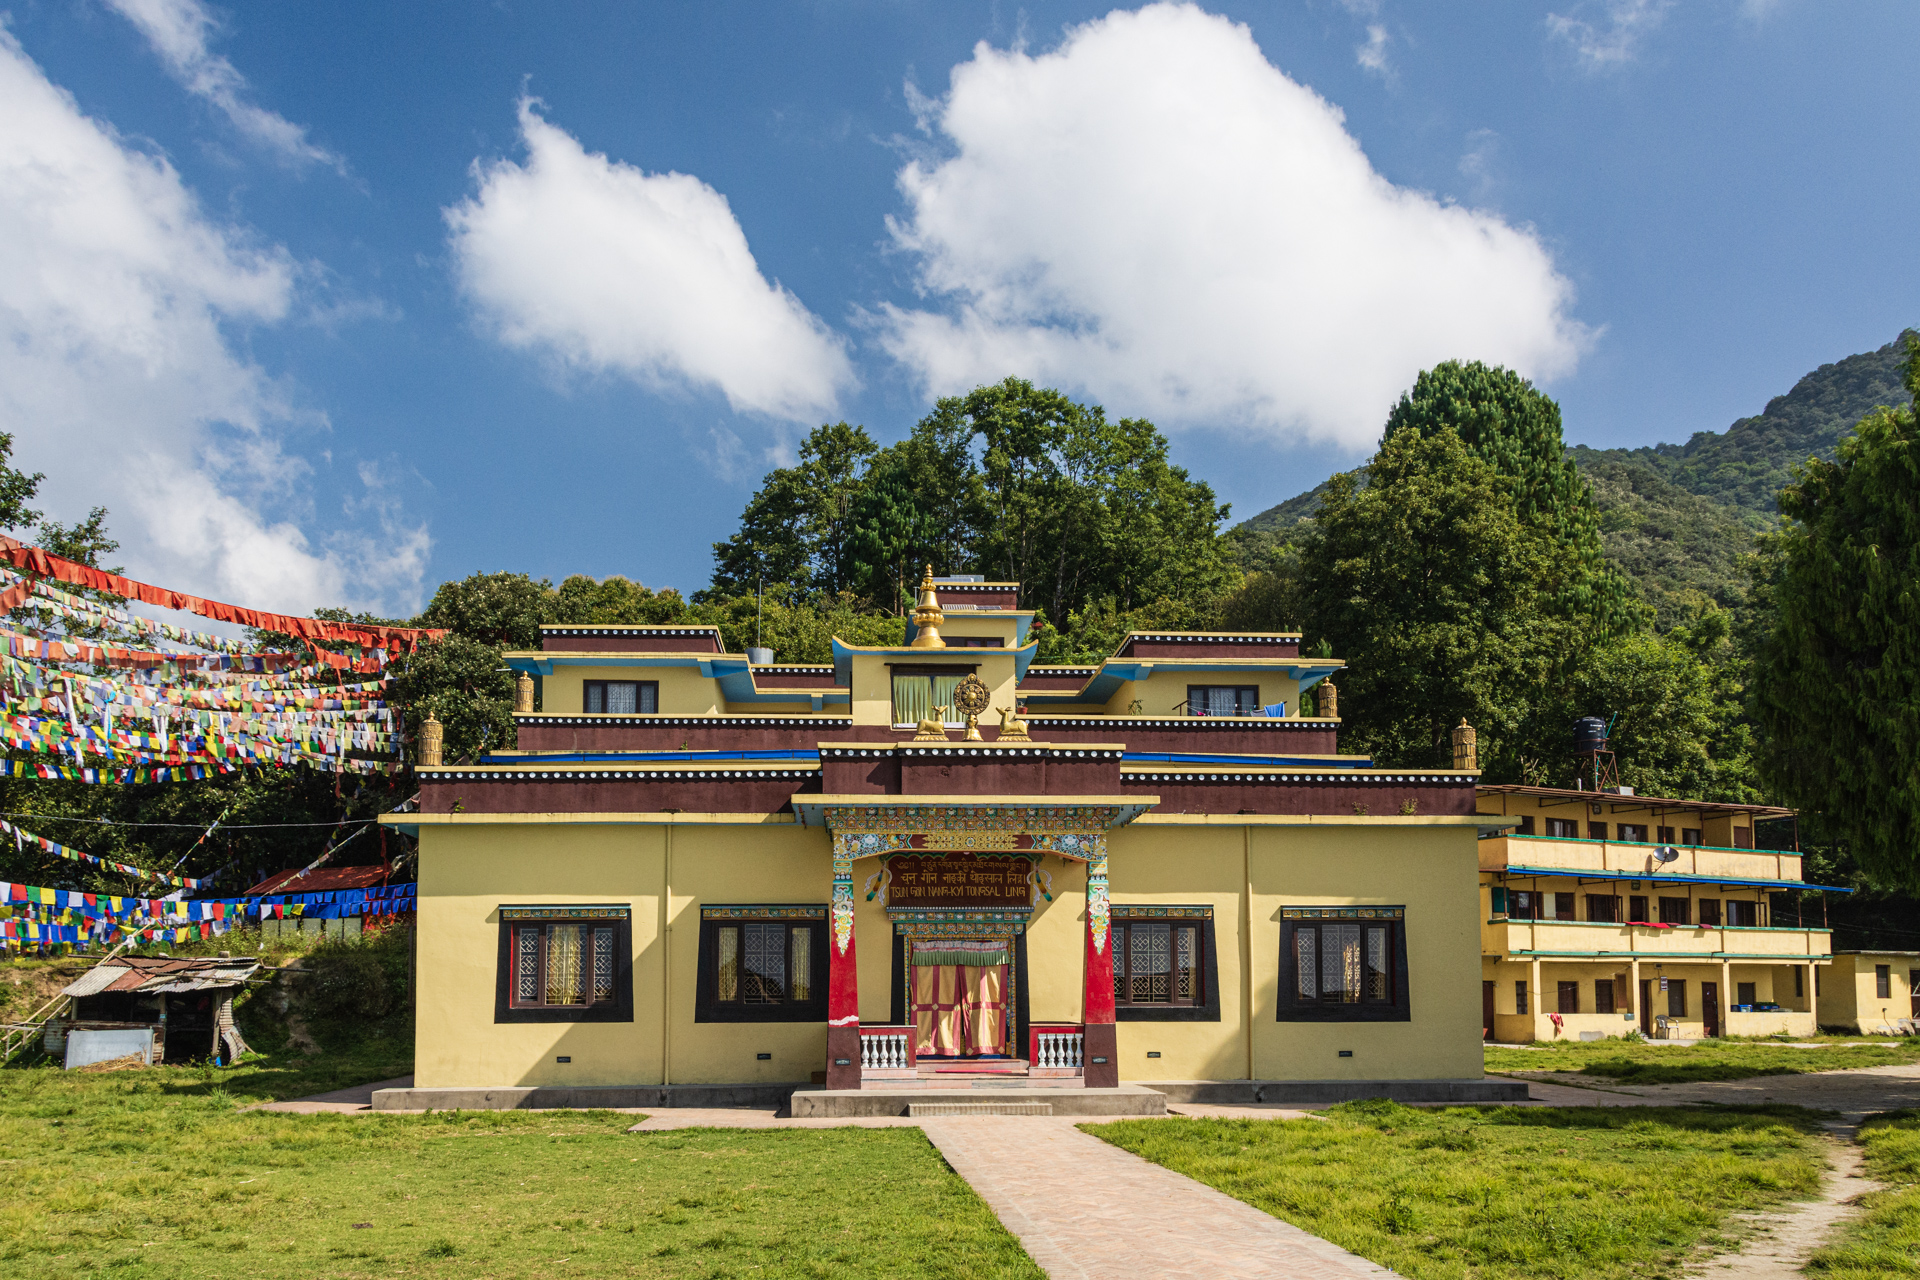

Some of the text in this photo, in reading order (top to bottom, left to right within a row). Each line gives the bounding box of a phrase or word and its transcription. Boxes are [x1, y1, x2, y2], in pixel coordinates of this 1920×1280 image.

[920, 870, 938, 884] गोन
[890, 886, 909, 898] TSUN
[965, 885, 1001, 897] TONGSAL
[1005, 886, 1026, 897] LING
